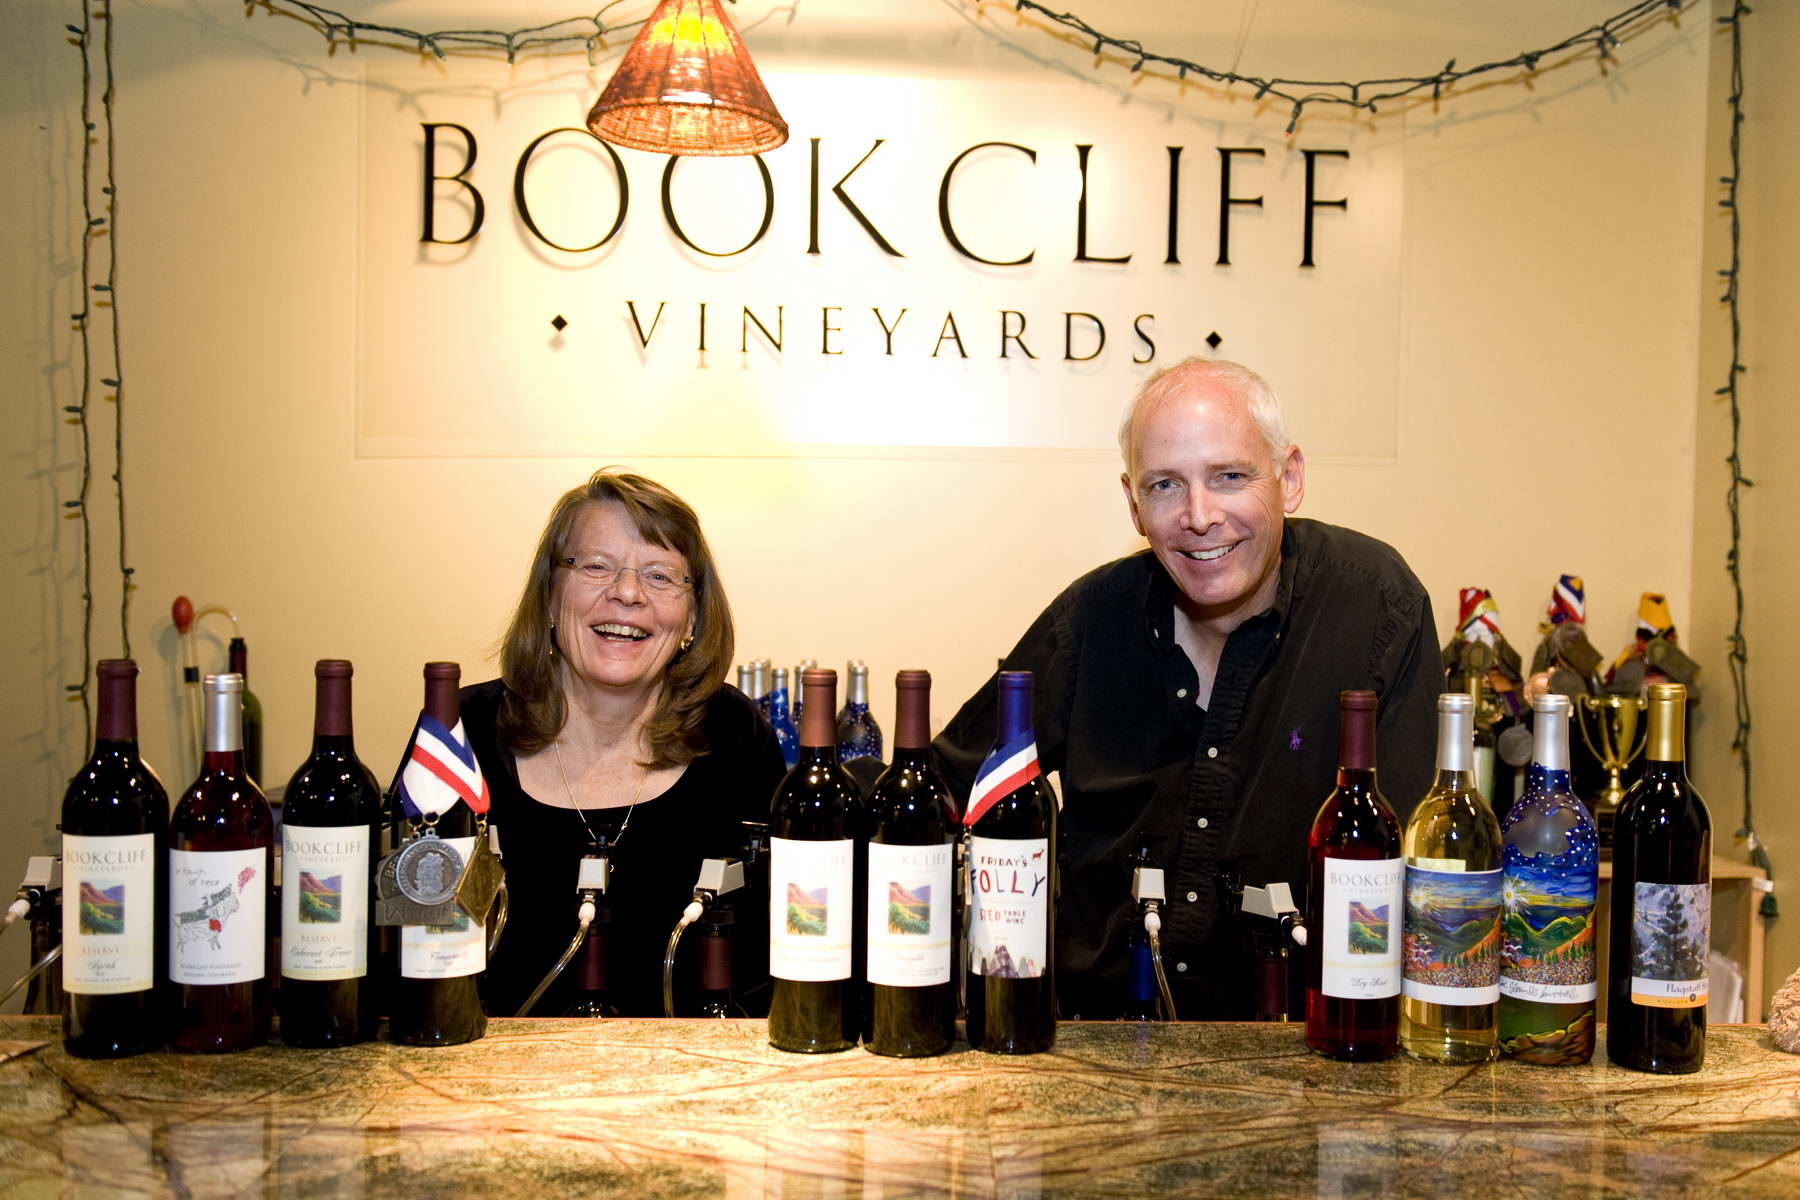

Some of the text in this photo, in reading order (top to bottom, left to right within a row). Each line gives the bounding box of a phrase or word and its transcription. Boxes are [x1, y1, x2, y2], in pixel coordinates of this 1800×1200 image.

[418, 121, 1349, 269] BOOKCLIFF
[626, 300, 1156, 365] VINEYARDS
[980, 854, 1028, 868] FRIDAY'S
[970, 867, 1046, 897] FOLLY
[980, 907, 1026, 922] RED TABLE
[1005, 917, 1025, 925] WINE
